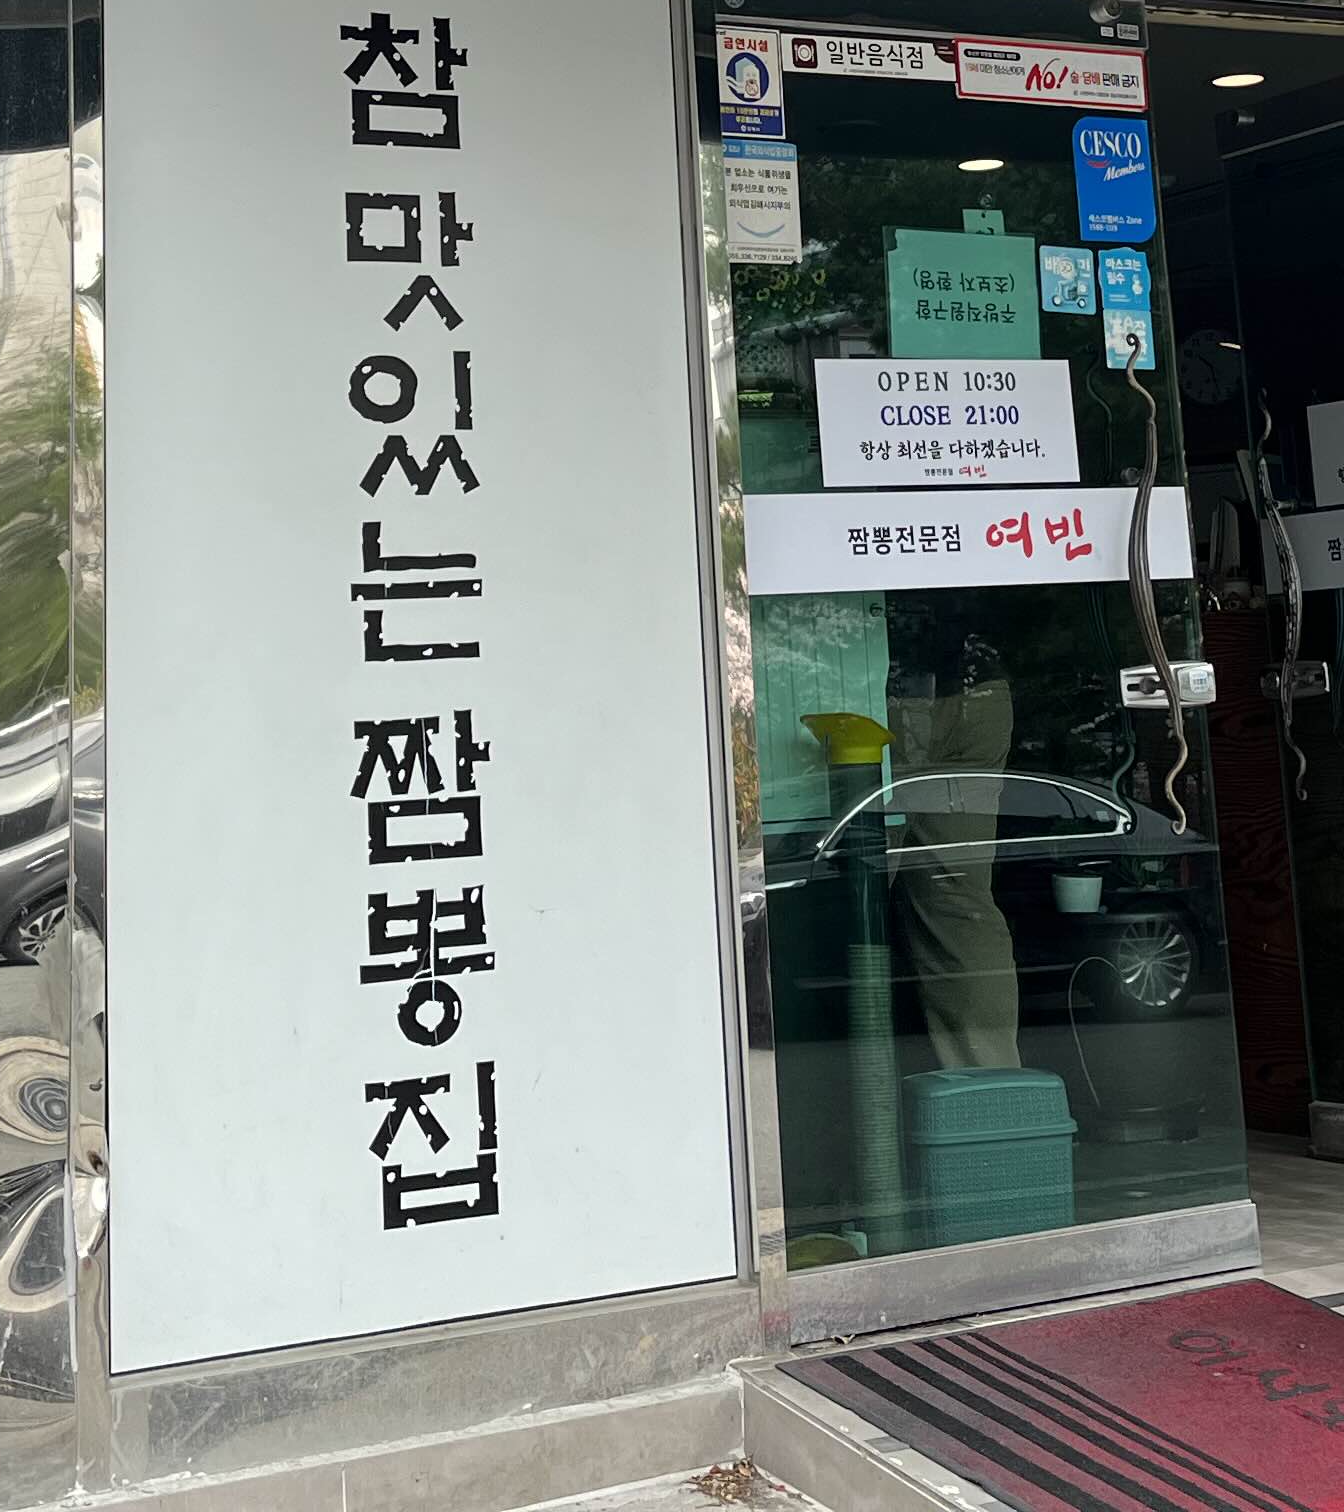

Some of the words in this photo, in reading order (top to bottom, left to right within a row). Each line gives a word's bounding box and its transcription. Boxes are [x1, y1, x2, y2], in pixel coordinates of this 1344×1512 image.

[723, 37, 768, 52] 금연시설
[826, 41, 923, 69] 일반음식점
[340, 12, 469, 150] 참
[1025, 62, 1069, 91] NO!
[1121, 74, 1139, 88] 금지
[1080, 129, 1142, 159] CESCO
[1103, 159, 1146, 182] Members
[913, 267, 953, 292] 환영)
[959, 272, 1015, 294] (초보자
[916, 299, 1016, 324] 주방직원구함
[877, 371, 949, 392] OPEN
[963, 370, 1016, 392] 10:30
[880, 405, 952, 426] CLOSE
[965, 405, 1019, 425] 21:00
[859, 440, 892, 461] 항상
[897, 439, 944, 460] 최선을
[948, 438, 1046, 459] 다하겠습니다.
[959, 464, 987, 478] 여빈
[848, 524, 961, 555] 짬뽕전문점
[986, 508, 1093, 561] 여빈
[350, 709, 500, 1230] 짬뽕집
